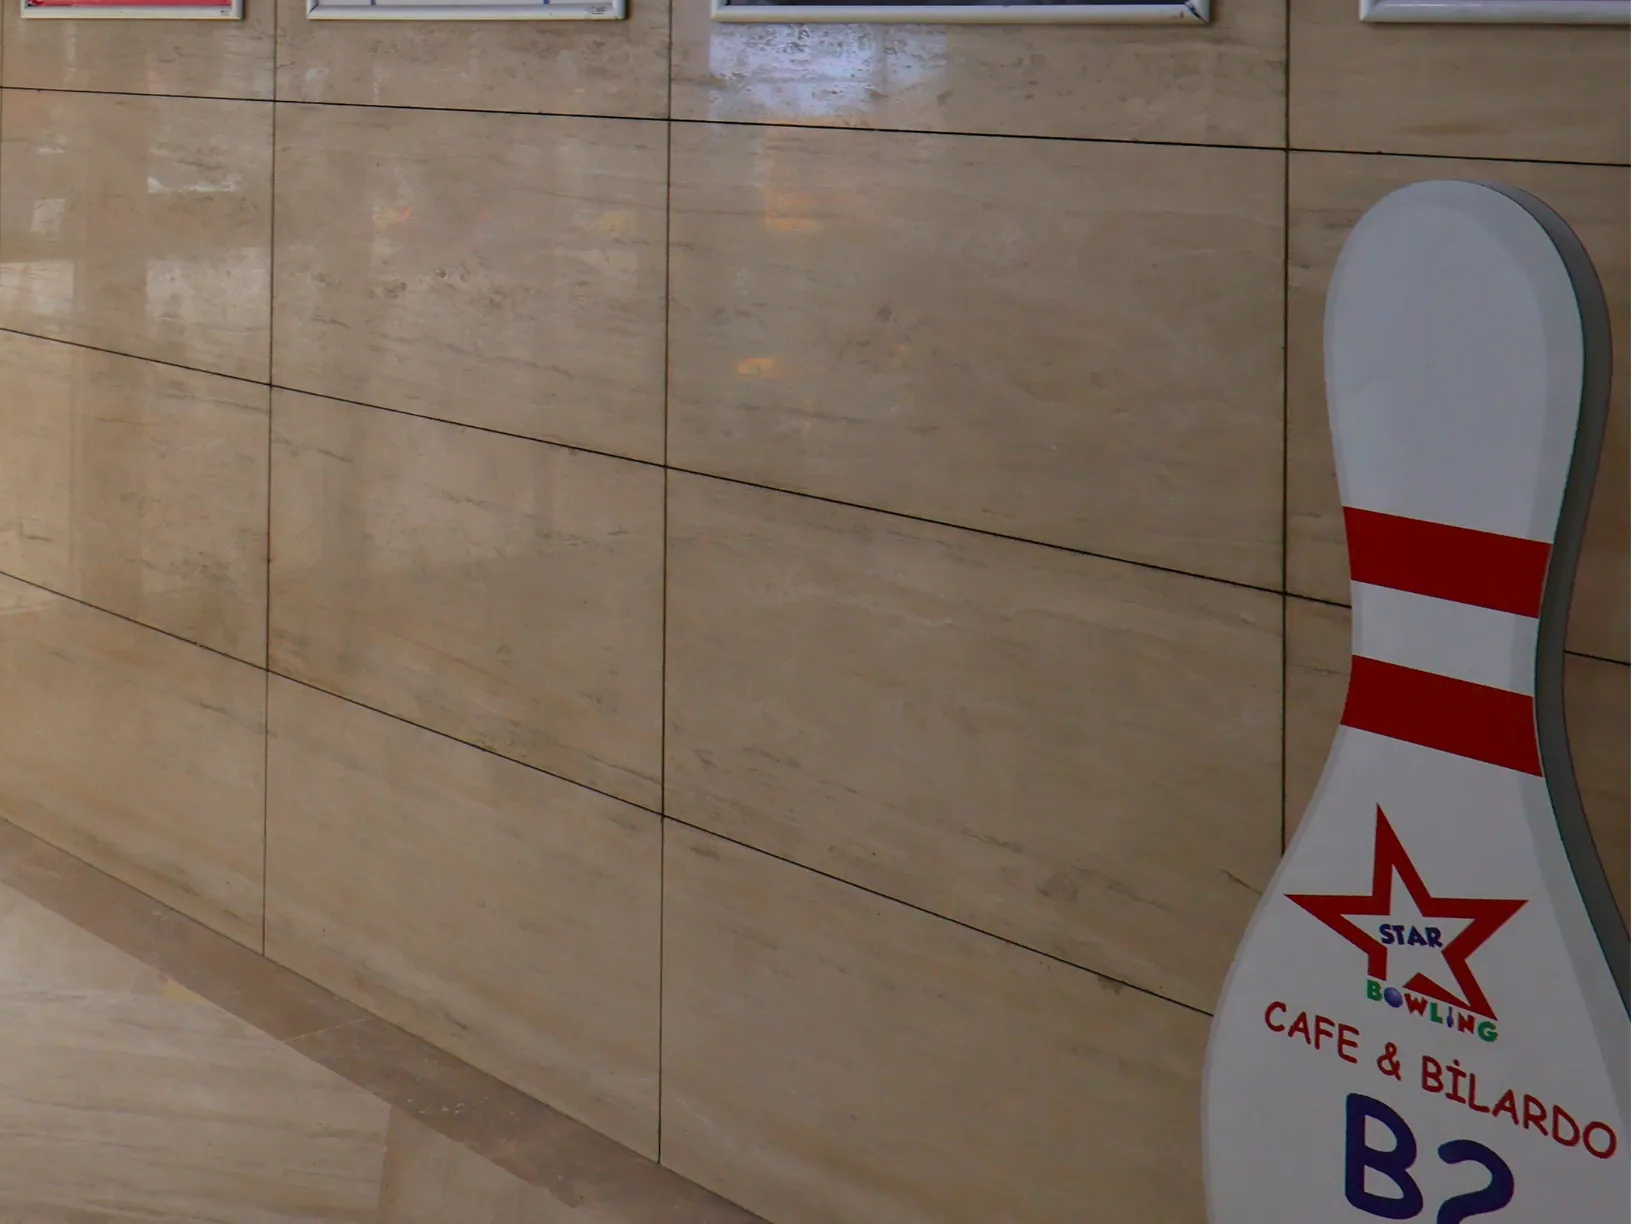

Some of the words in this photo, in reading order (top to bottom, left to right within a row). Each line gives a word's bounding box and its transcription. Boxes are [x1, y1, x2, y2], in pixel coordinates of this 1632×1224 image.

[1379, 923, 1444, 949] STAR
[1265, 1001, 1360, 1064] CAFE
[1377, 1042, 1402, 1081] &
[1421, 1055, 1616, 1159] BİLARDO
